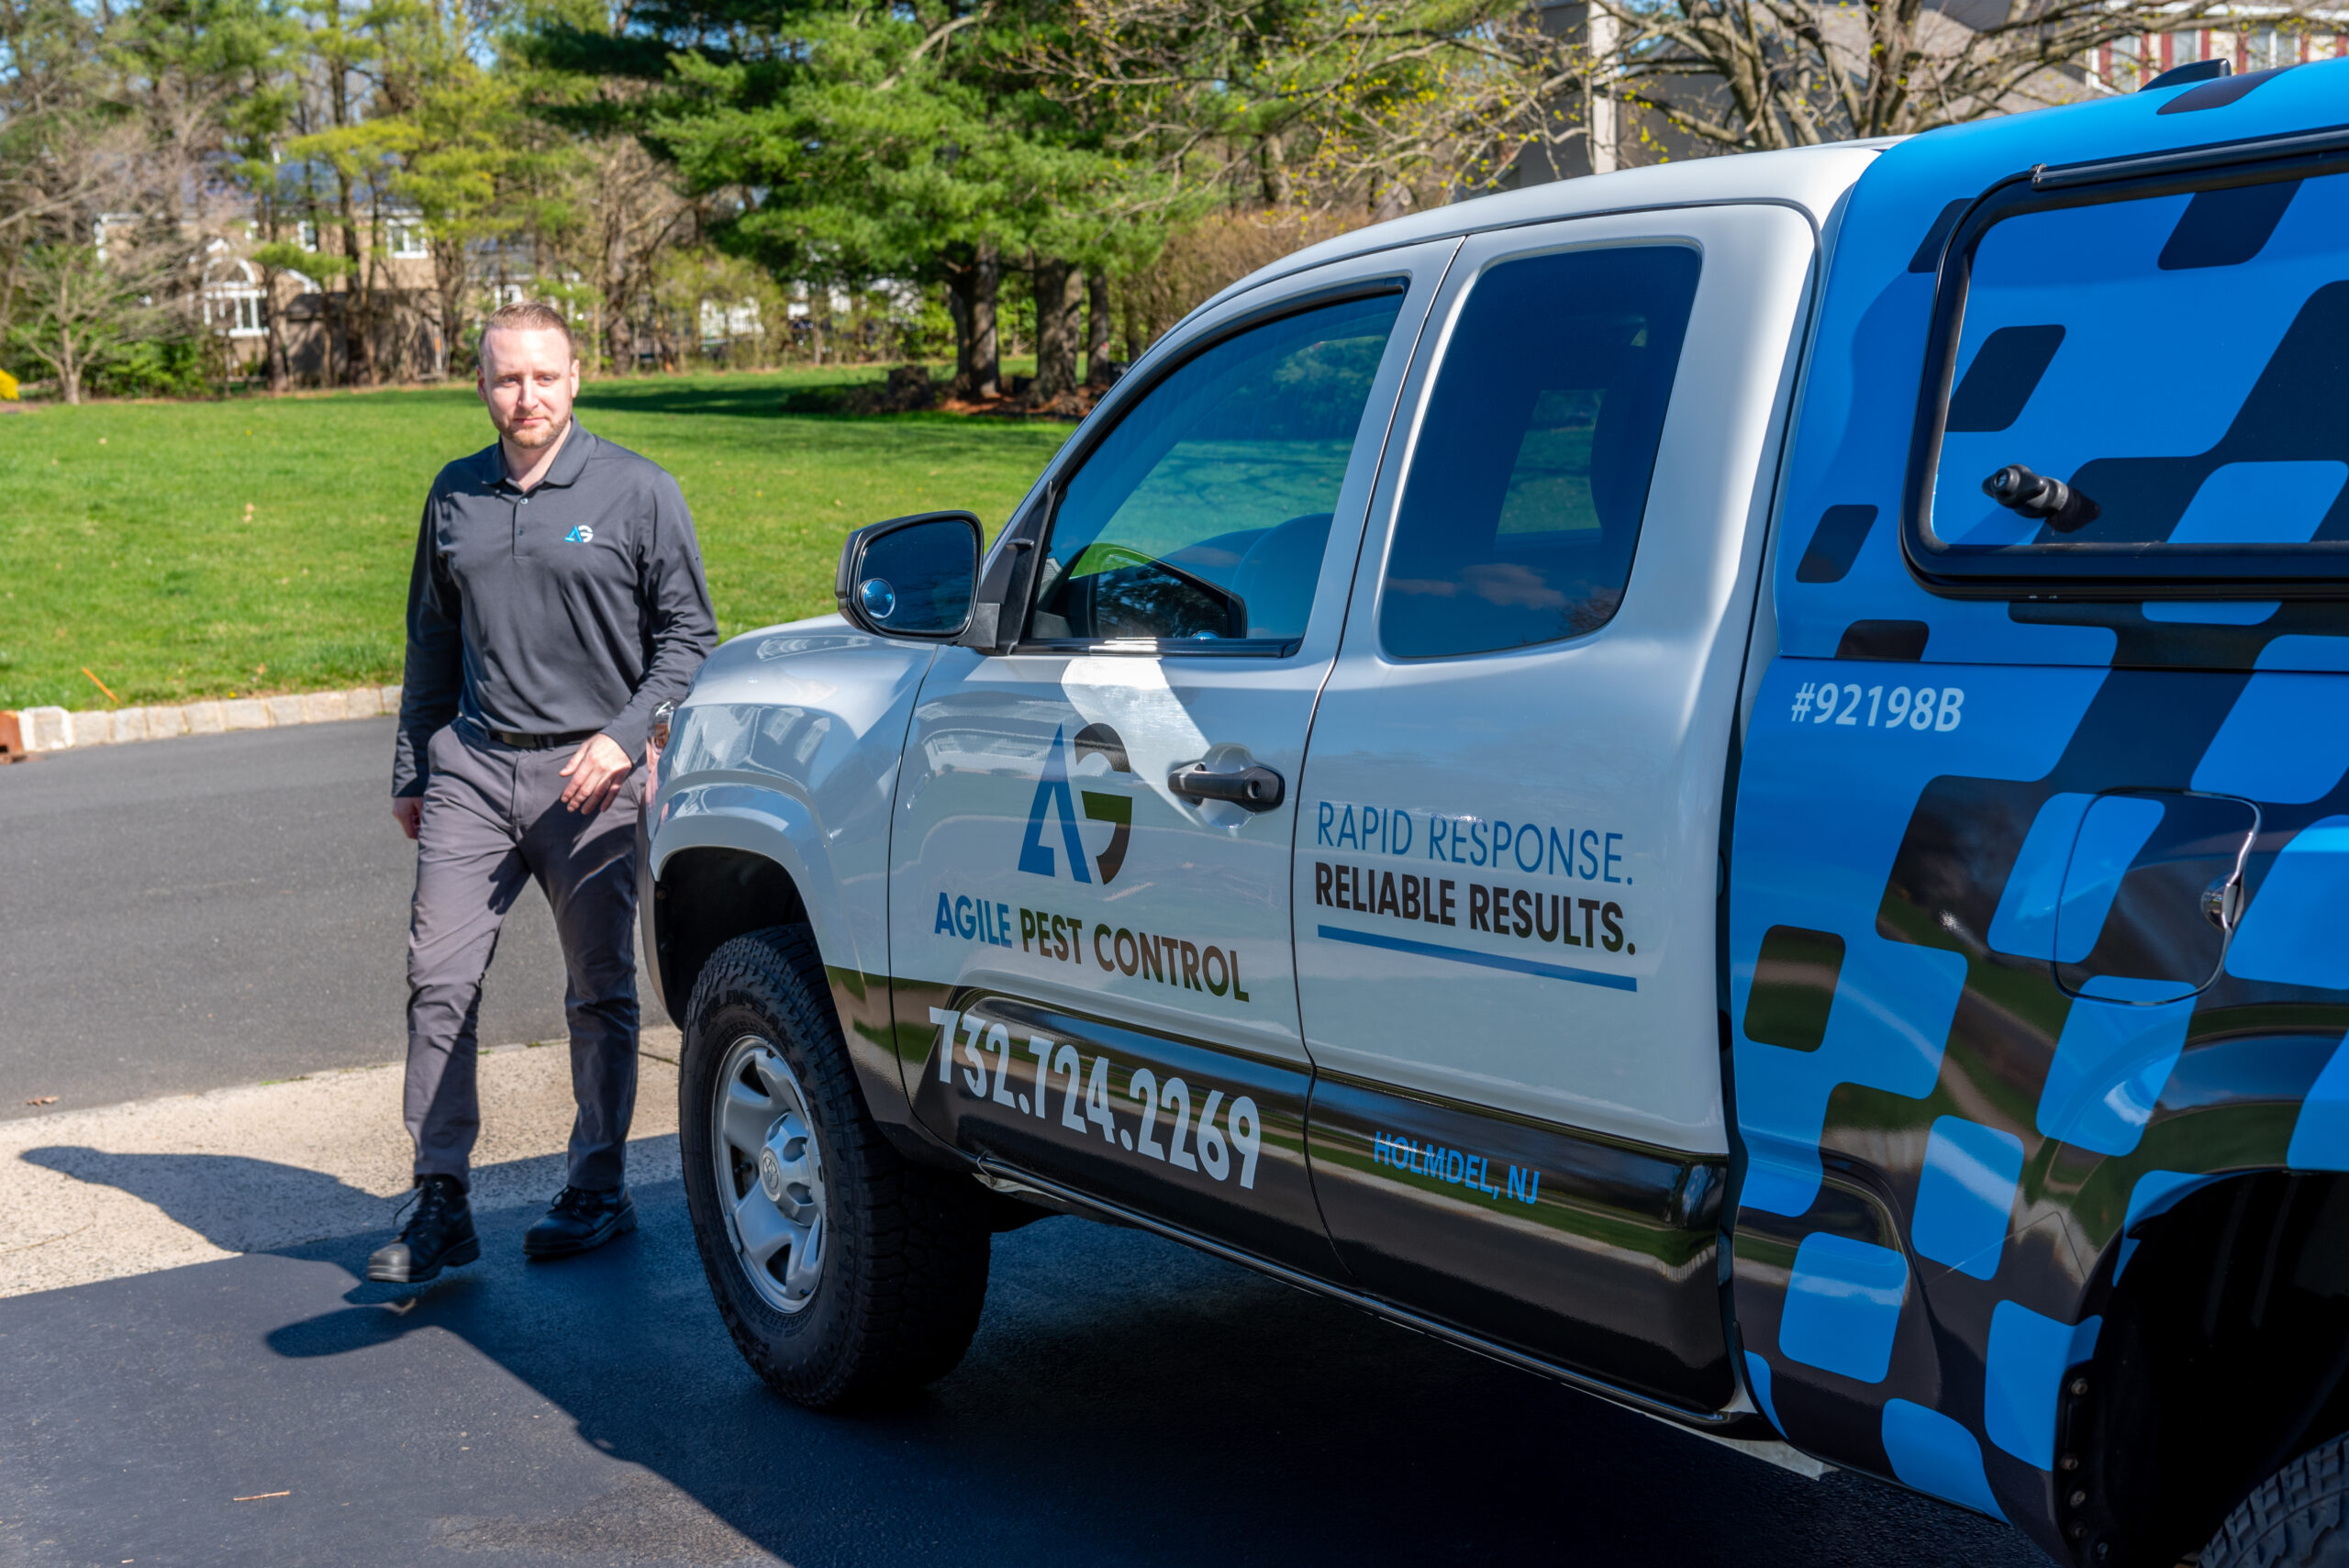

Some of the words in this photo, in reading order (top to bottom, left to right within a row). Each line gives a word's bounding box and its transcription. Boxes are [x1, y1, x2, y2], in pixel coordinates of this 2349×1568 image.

[1791, 682, 1965, 732] #92198B
[1318, 801, 1412, 855] RAPID
[1429, 813, 1633, 885] RESPONSE.
[934, 892, 1012, 949] AGILE
[1019, 907, 1083, 964] PEST
[1094, 923, 1250, 1003] CONTROL
[1315, 862, 1456, 927] RELIABLE
[1470, 883, 1636, 956] RESULTS.
[929, 1006, 1261, 1189] 732.724.2269
[1374, 1130, 1500, 1201] HOLMDEL,
[1507, 1164, 1541, 1205] NJ
